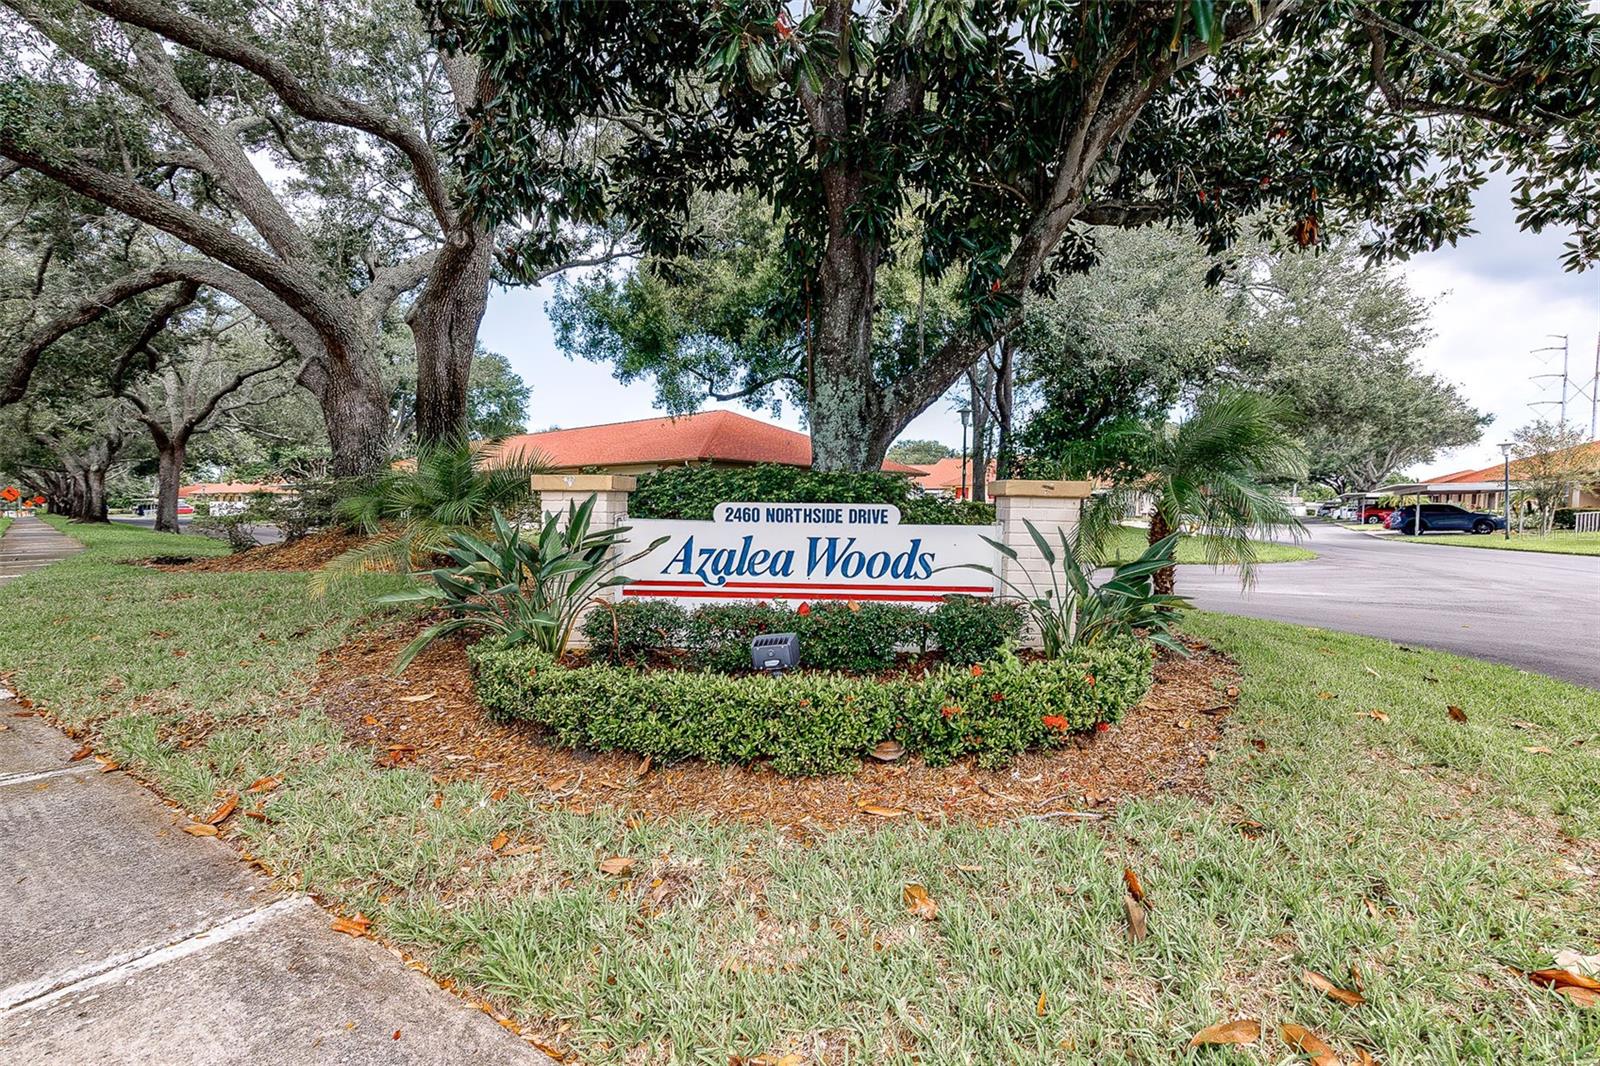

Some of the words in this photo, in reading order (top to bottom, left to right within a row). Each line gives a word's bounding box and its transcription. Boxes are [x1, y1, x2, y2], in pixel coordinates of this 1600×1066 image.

[725, 507, 760, 523] 2460
[766, 508, 843, 524] NORTHSIDE
[849, 509, 888, 524] DRIVE
[660, 535, 795, 586] Azalea
[806, 537, 935, 580] Woods
